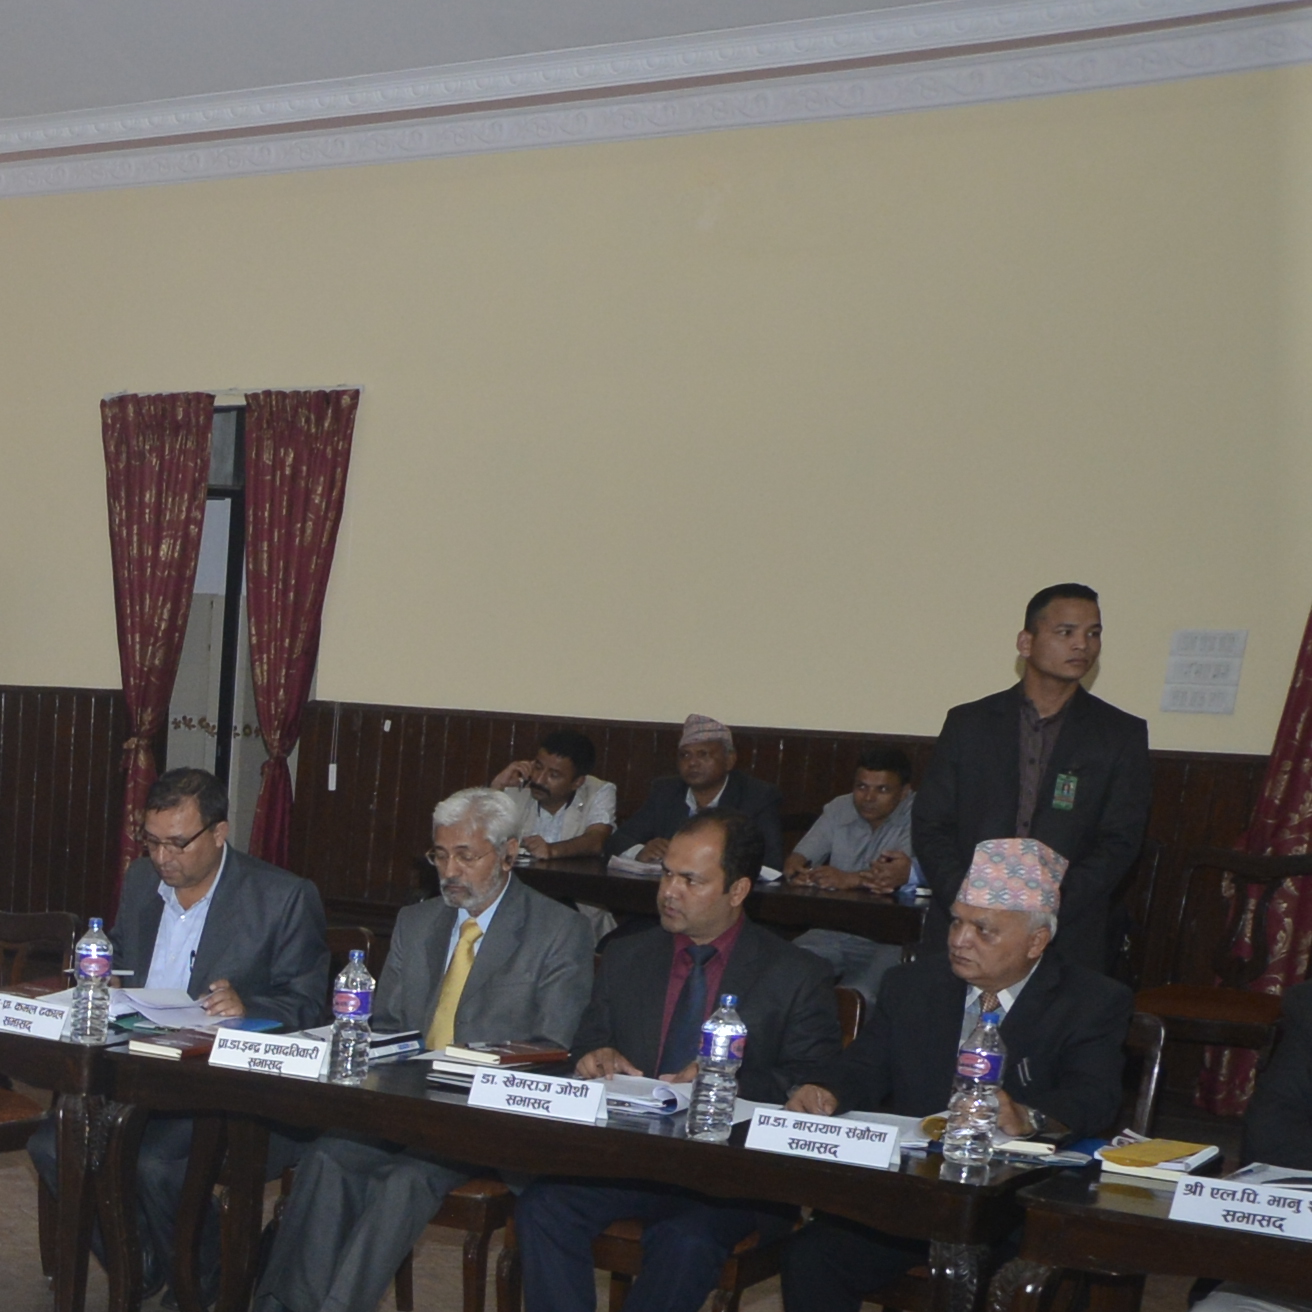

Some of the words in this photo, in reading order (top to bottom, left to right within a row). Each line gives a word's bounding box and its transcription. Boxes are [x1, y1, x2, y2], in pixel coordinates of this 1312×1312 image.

[502, 1074, 553, 1093] खेमराज
[555, 1081, 590, 1098] जोशी
[792, 1119, 842, 1136] नारायण
[845, 1125, 889, 1143] संग्रौला
[1182, 1181, 1205, 1198] श्री
[1266, 1194, 1303, 1214] भानु
